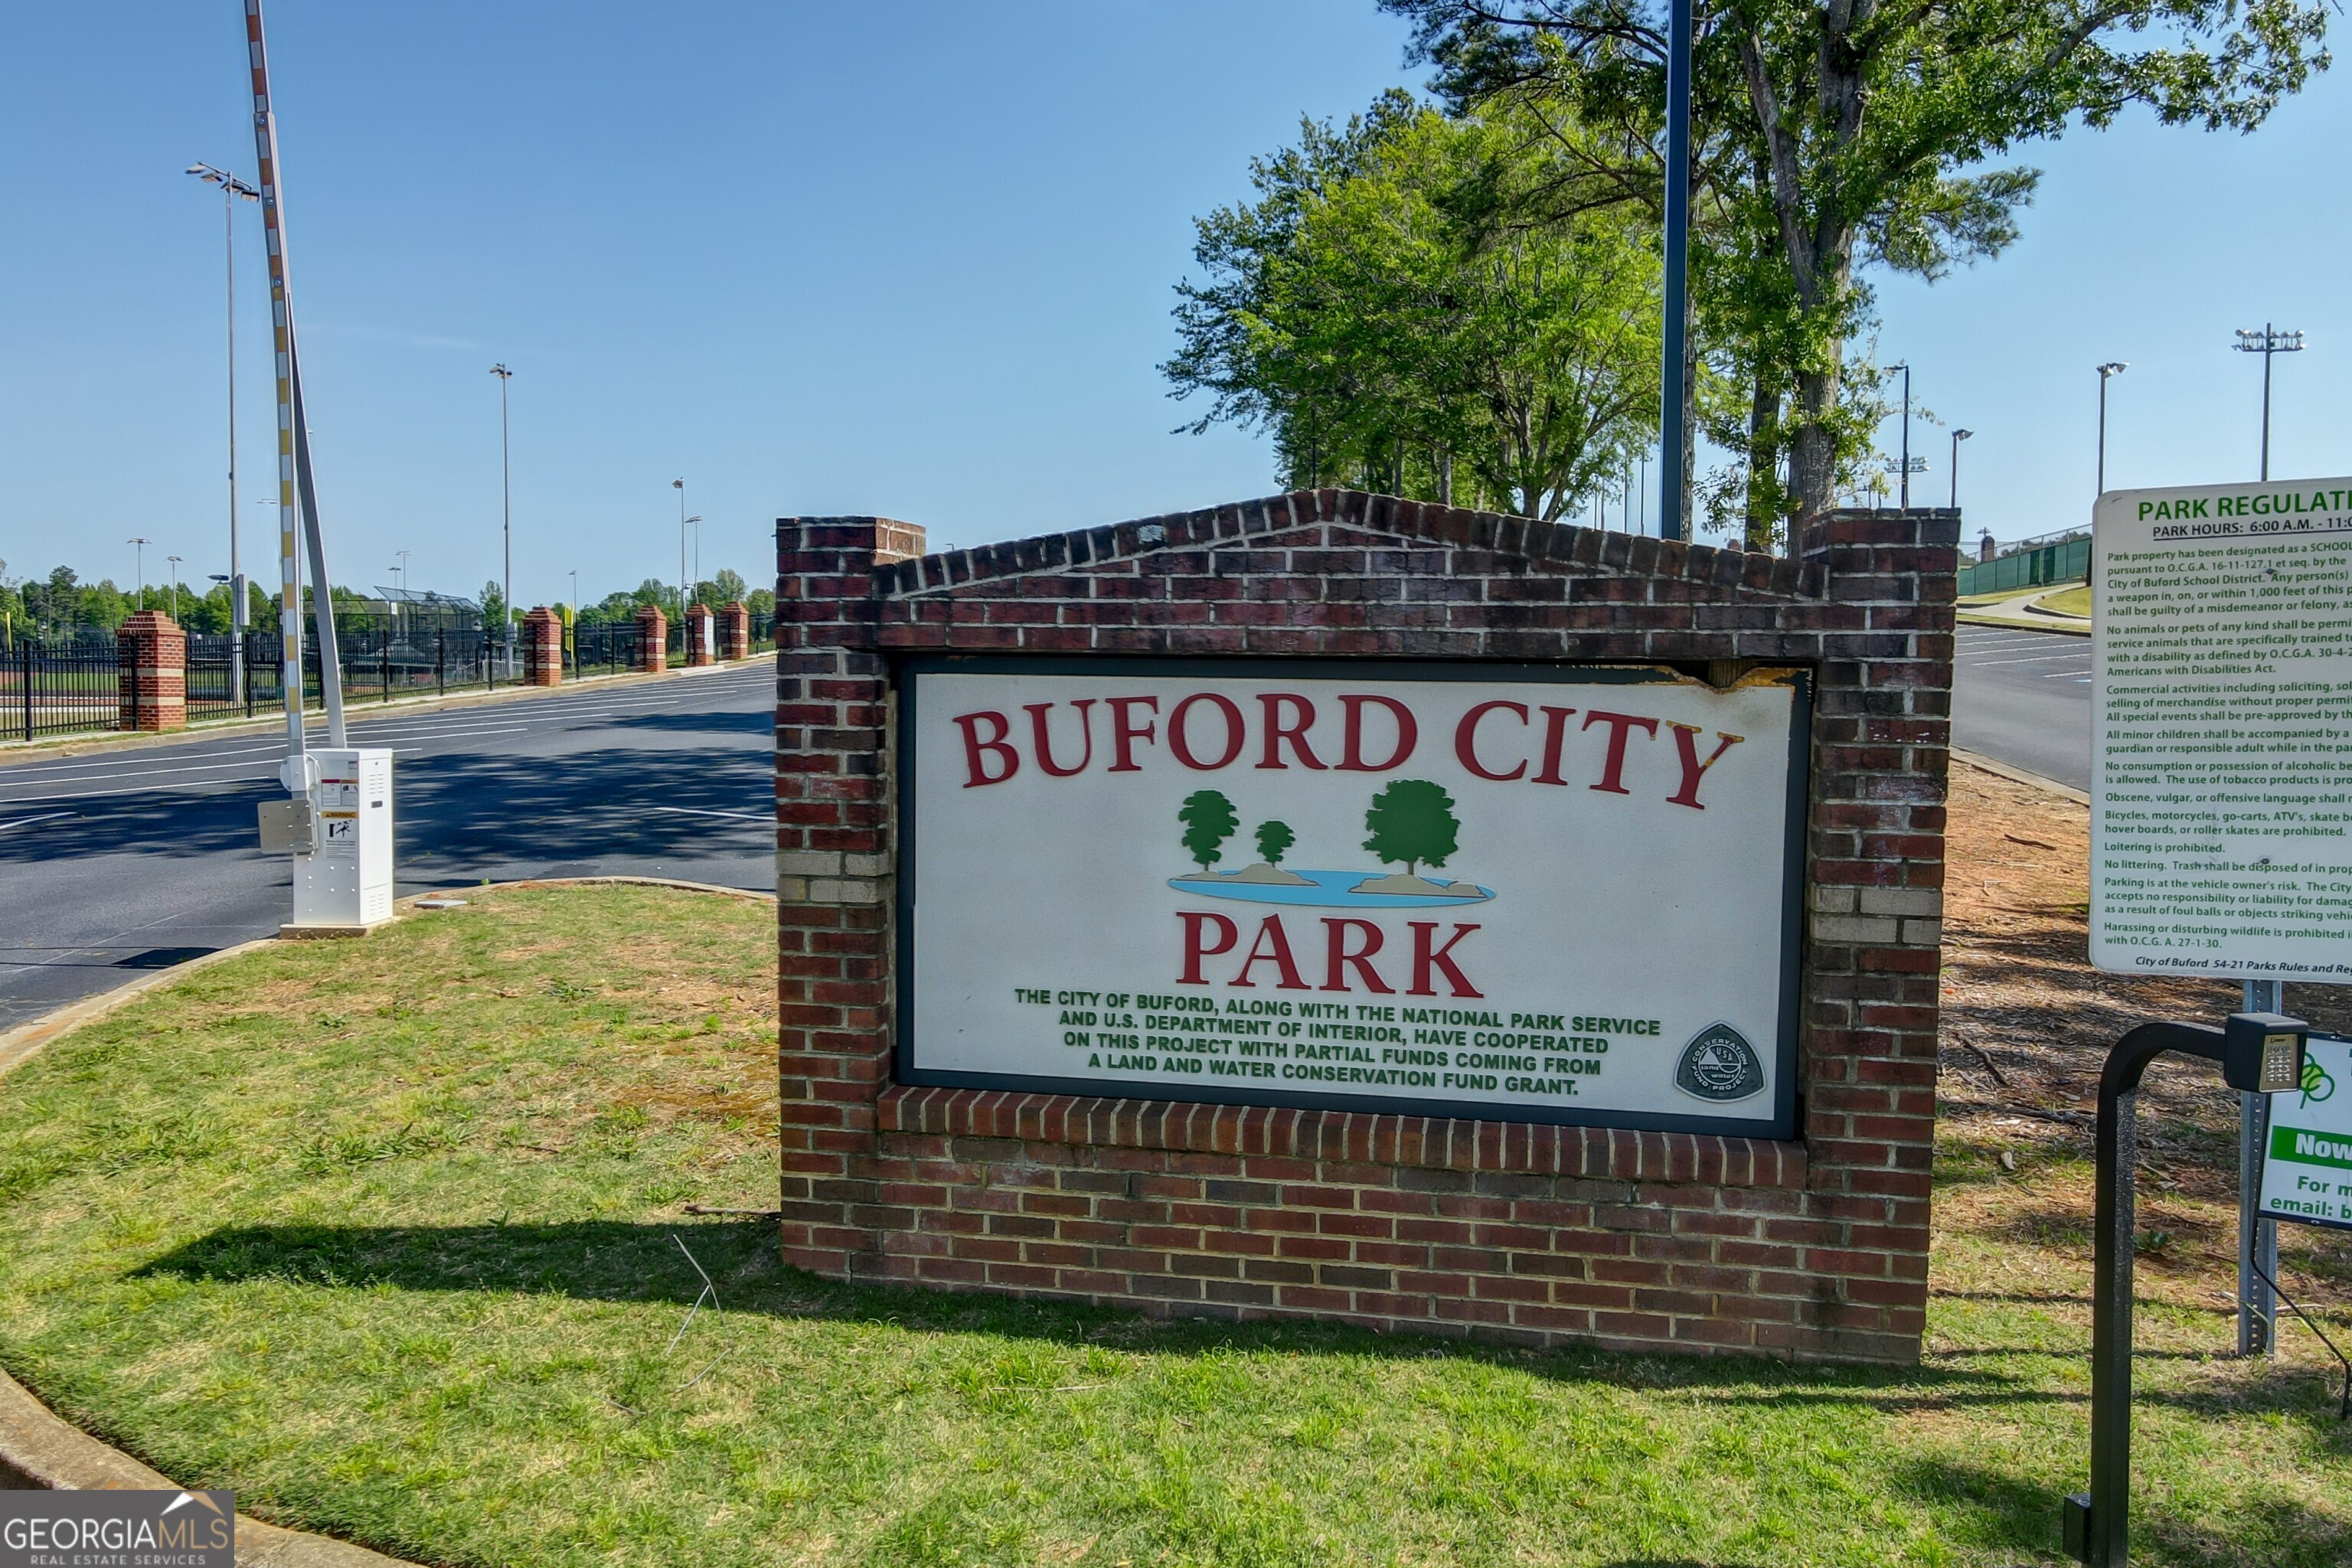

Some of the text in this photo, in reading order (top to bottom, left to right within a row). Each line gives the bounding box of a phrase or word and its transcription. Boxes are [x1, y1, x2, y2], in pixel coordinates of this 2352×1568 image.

[2138, 498, 2210, 521] PARK
[2153, 525, 2188, 537] PARK
[2191, 522, 2243, 535] HOURS:
[2249, 521, 2279, 532] 6:00
[2282, 518, 2314, 531] A.M.
[2108, 552, 2129, 561] Park
[2132, 551, 2176, 563] property
[2178, 549, 2196, 558] has
[2198, 548, 2223, 557] been
[2226, 544, 2285, 557] designated
[2108, 566, 2152, 577] pursuant
[2167, 563, 2208, 573] O.C.G.A.
[2212, 560, 2272, 570] 16-11-127.1
[2289, 560, 2310, 569] seq.
[2313, 557, 2326, 568] by
[2328, 556, 2347, 565] the
[2108, 580, 2128, 590] City
[2130, 578, 2141, 588] of
[2144, 577, 2180, 587] Buford
[2183, 575, 2220, 586] School
[2271, 573, 2292, 583] Any
[2296, 570, 2349, 583] person(s)
[2107, 639, 2144, 648] service
[2146, 637, 2188, 648] animals
[2190, 636, 2213, 646] that
[2236, 634, 2298, 647] specifically
[2301, 632, 2342, 643] trained
[2107, 664, 2276, 676] Americans with Disabilities Act.
[2106, 684, 2169, 694] Commercial
[2172, 684, 2221, 694] activities
[2223, 683, 2275, 694] including
[2278, 681, 2333, 694] soliciting,
[2106, 730, 2120, 740] All
[2122, 730, 2154, 739] minor
[2157, 730, 2200, 739] children
[2203, 729, 2229, 739] shall
[2232, 729, 2245, 738] be
[2248, 728, 2323, 740] accompanied
[2326, 728, 2340, 740] by
[952, 693, 1744, 809] BUFORD CITY
[2105, 792, 2153, 803] Obscene,
[2156, 792, 2193, 805] vulgar,
[2210, 792, 2260, 802] offensive
[2263, 793, 2316, 805] language
[2318, 793, 2345, 803] shall
[2105, 824, 2135, 833] hover
[2138, 824, 2177, 835] boards,
[2194, 825, 2223, 835] roller
[2226, 825, 2260, 835] skates
[2283, 826, 2347, 838] prohibited.
[2105, 842, 2226, 854] Loitering is prohibited.
[2105, 860, 2119, 868] No
[2122, 859, 2167, 872] littering.
[2173, 861, 2201, 871] Trash
[2204, 861, 2230, 871] shall
[2232, 862, 2246, 871] be
[2249, 863, 2298, 874] disposed
[2301, 863, 2313, 873] of
[2315, 864, 2325, 873] in
[2105, 877, 2145, 889] Parking
[2147, 878, 2155, 887] is
[2171, 878, 2188, 888] the
[2191, 879, 2230, 889] vehicle
[2232, 880, 2275, 890] owner's
[2278, 881, 2301, 890] risk.
[2306, 882, 2327, 891] The
[2330, 882, 2352, 894] City
[2105, 936, 2128, 945] with
[2177, 938, 2222, 948] 27-1-30.
[1176, 911, 1483, 999] PARK
[2135, 956, 2157, 968] City
[2158, 958, 2170, 967] of
[2171, 958, 2208, 968] Buford
[2212, 959, 2243, 969] 54-21
[2246, 961, 2277, 971] Parks
[2278, 962, 2309, 972] Rules
[2311, 964, 2334, 973] and
[1014, 988, 1661, 1036] THE CITY OF BUFORD, ALONG WITH THE NATIONAL PARK SERVICE
[1059, 1011, 1609, 1054] AND U.S. DEPARTMENT OF INTERIOR, HAVE COOPERATED
[1064, 1031, 1600, 1075] ON THIS PROJECT WITH PARTIAL FUNDS COMING FROM
[1692, 1039, 1748, 1065] CONSERVATION
[1716, 1047, 1733, 1061] USA
[1088, 1053, 1578, 1096] A LAND AND WATER CONSERVATION FUND GRANT.
[1691, 1066, 1747, 1091] FUND PROJECT
[2298, 1175, 2330, 1193] For
[2270, 1197, 2333, 1217] email:
